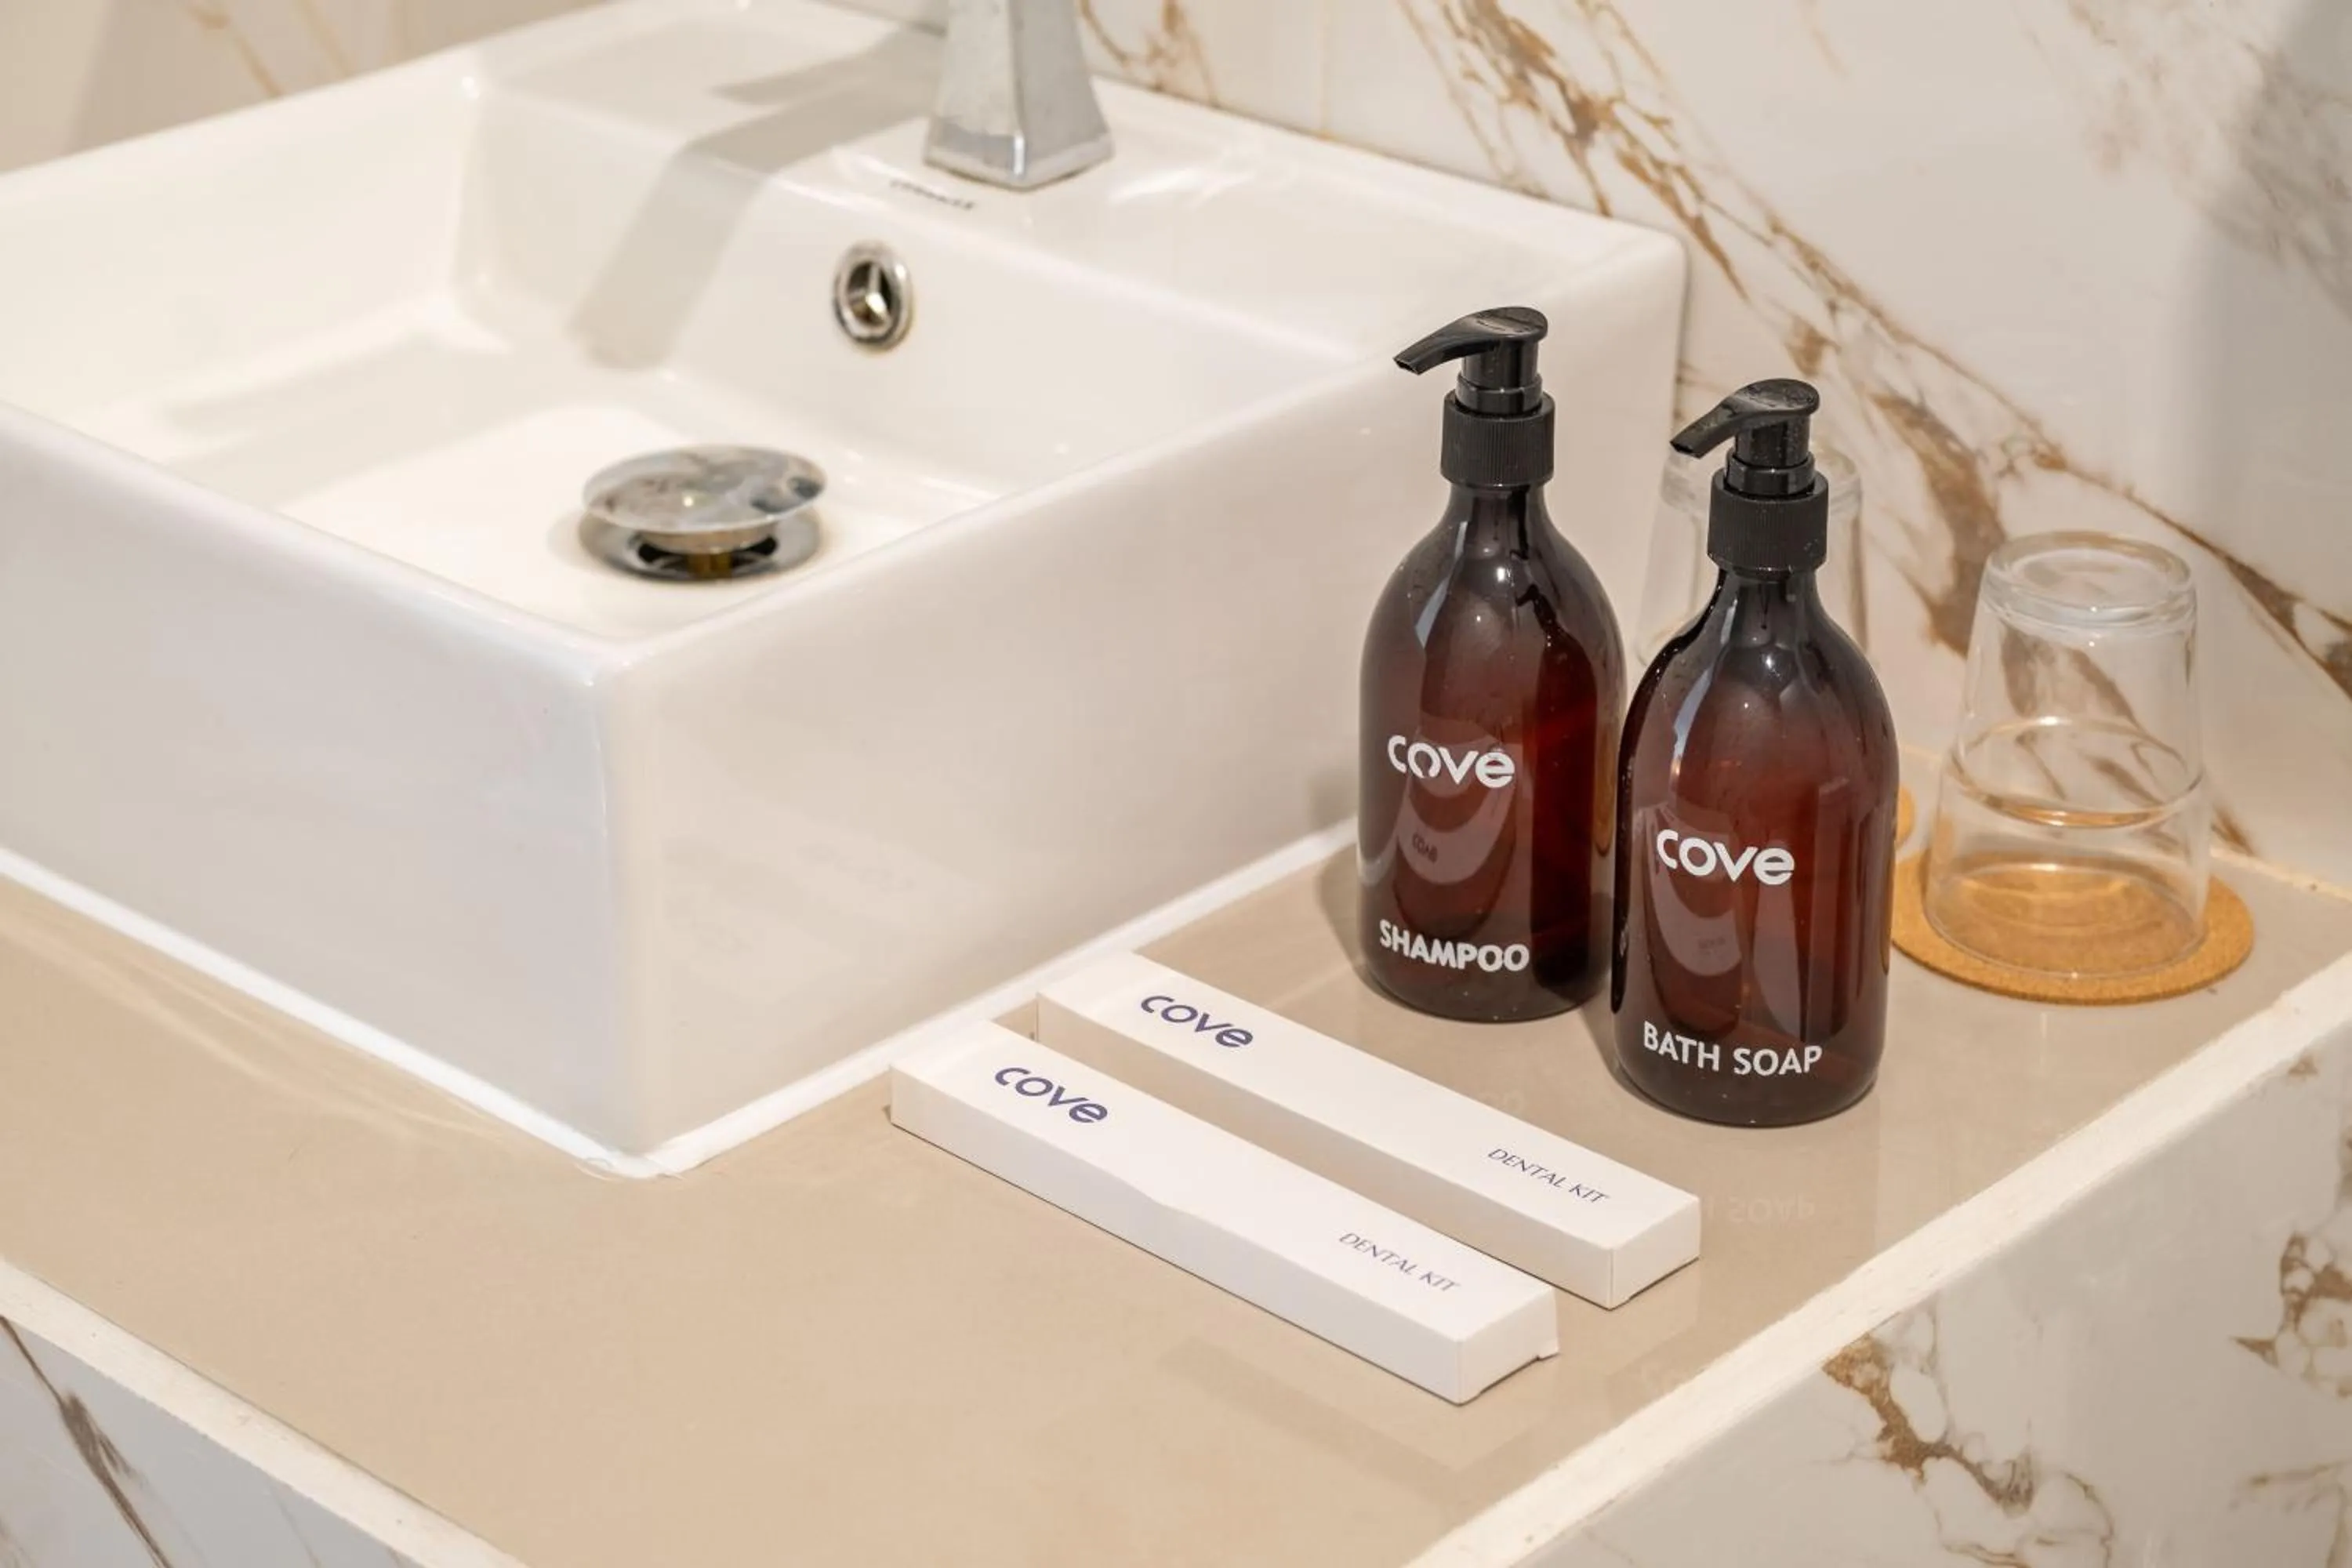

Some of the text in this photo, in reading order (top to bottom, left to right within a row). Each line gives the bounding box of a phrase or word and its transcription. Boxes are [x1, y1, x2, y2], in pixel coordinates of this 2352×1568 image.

[1387, 734, 1516, 789] cove
[1655, 828, 1795, 886] cove
[1379, 919, 1530, 973] SHAMPOO
[1140, 995, 1254, 1049] cove
[1643, 1020, 1823, 1077] BATH SOAP
[994, 1066, 1109, 1124] cove
[1486, 1147, 1610, 1203] DENTAL KIT
[1338, 1232, 1460, 1292] DENTAL KIT
